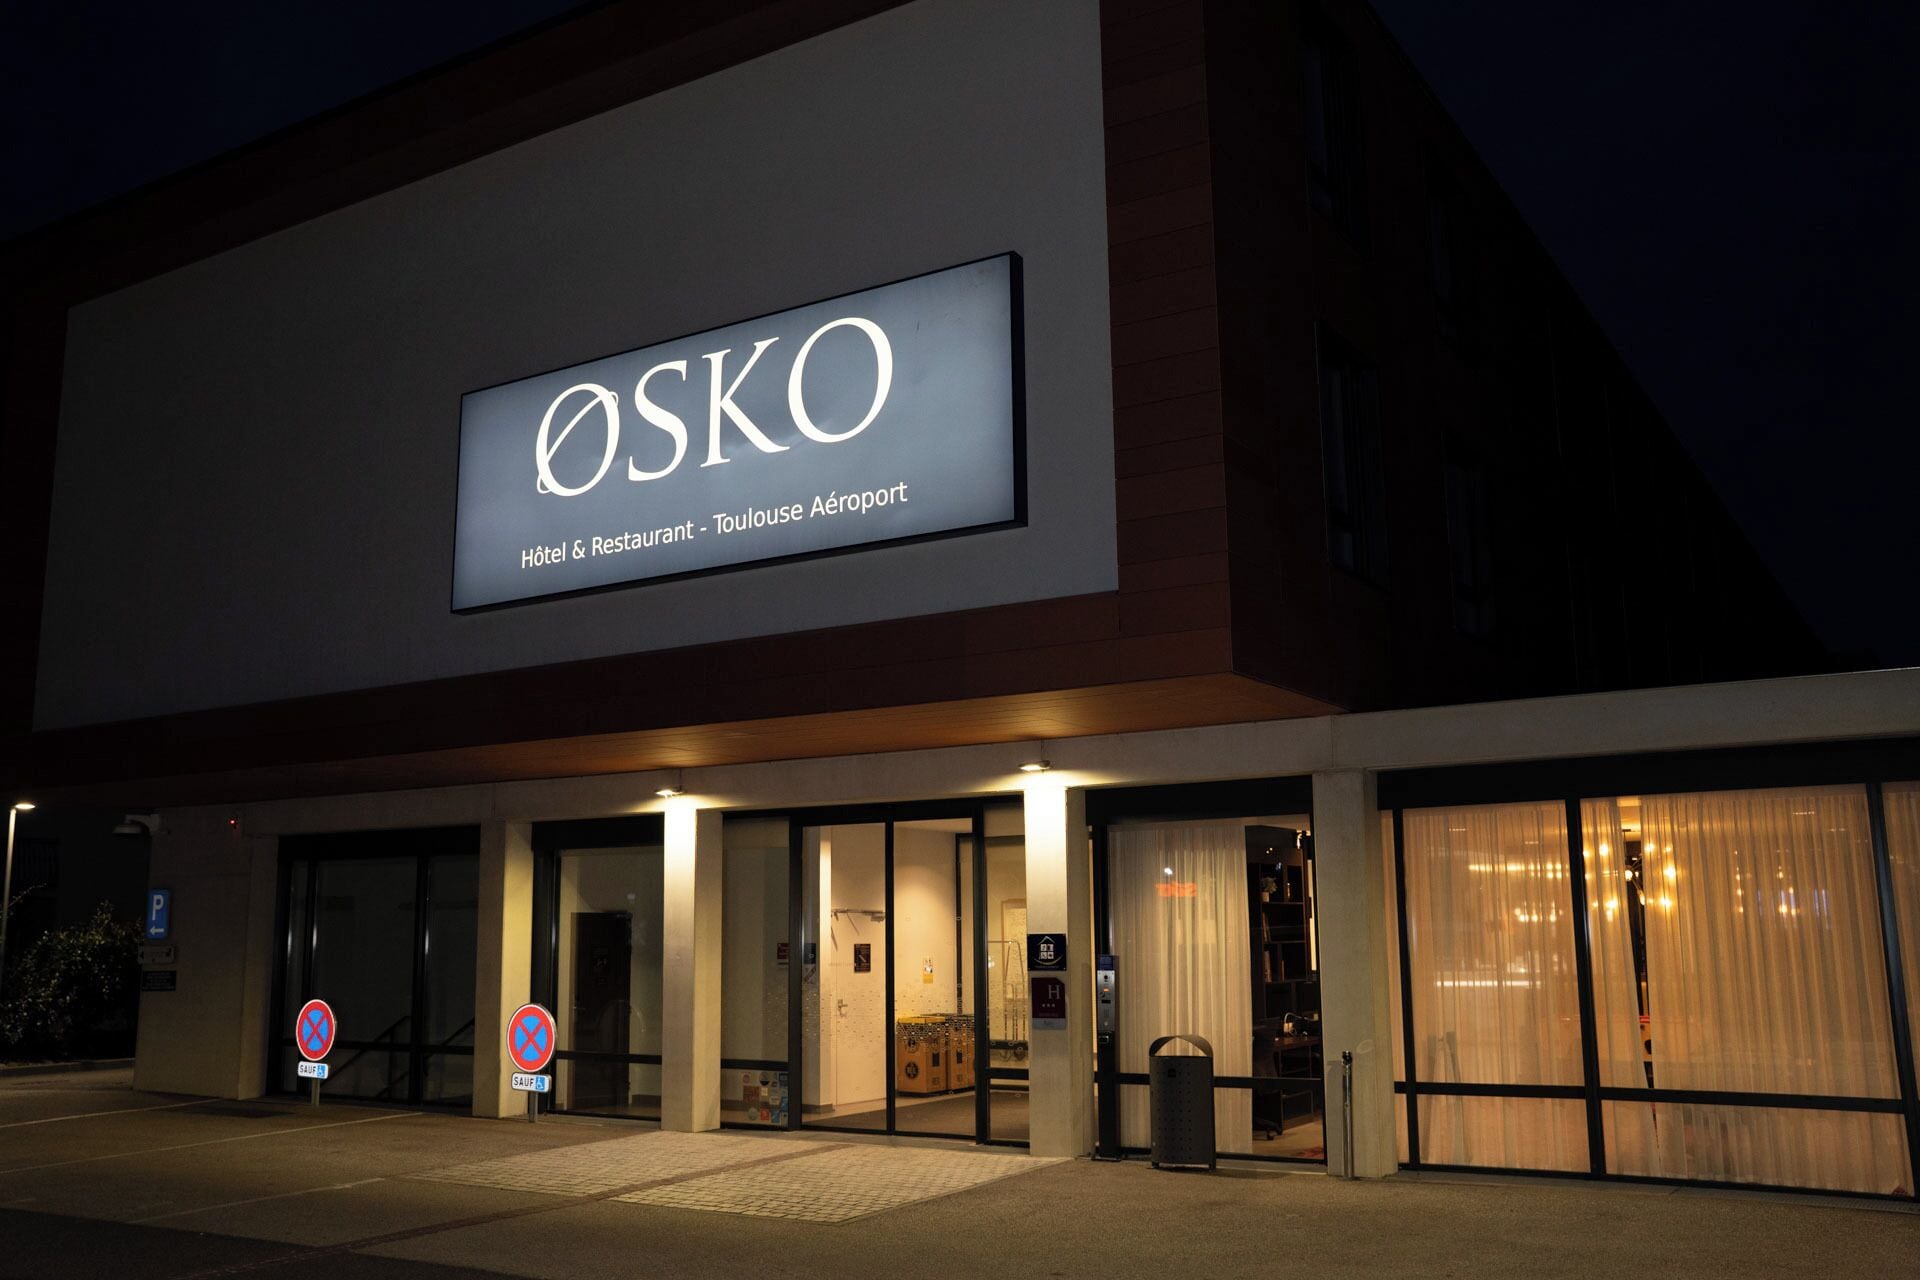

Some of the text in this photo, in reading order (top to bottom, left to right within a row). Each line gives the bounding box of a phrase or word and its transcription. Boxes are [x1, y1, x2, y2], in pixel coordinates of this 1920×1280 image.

[521, 541, 567, 569] Hôtel
[572, 539, 586, 560] &
[591, 520, 694, 557] Restaurant
[712, 505, 804, 535] Toulouse
[809, 481, 908, 518] Aéroport
[152, 894, 164, 921] P
[300, 1064, 316, 1074] SAUF
[513, 1076, 534, 1088] SAUF
